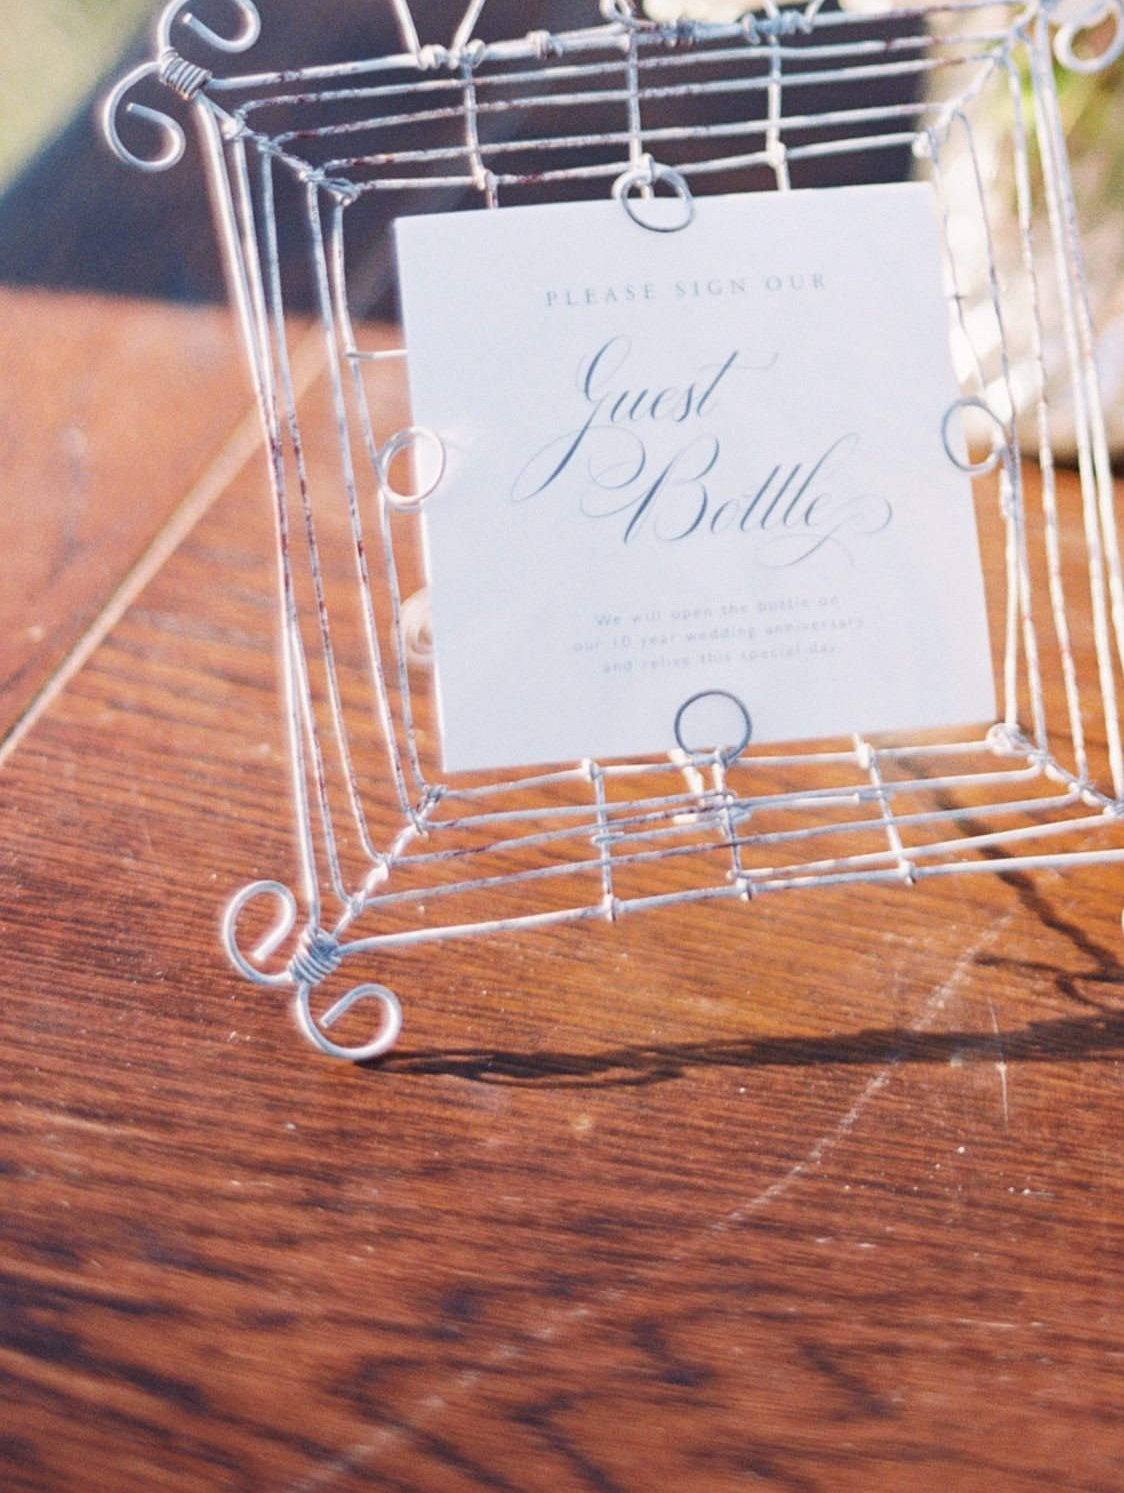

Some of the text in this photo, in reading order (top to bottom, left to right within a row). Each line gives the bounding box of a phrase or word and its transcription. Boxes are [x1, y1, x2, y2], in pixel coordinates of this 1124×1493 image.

[545, 271, 827, 307] PLEASE SIGN OUR
[510, 333, 778, 503] Guest
[579, 431, 893, 569] Bottle
[594, 613, 622, 626] We
[631, 609, 662, 623] will
[670, 606, 713, 621] open
[721, 603, 749, 616] the
